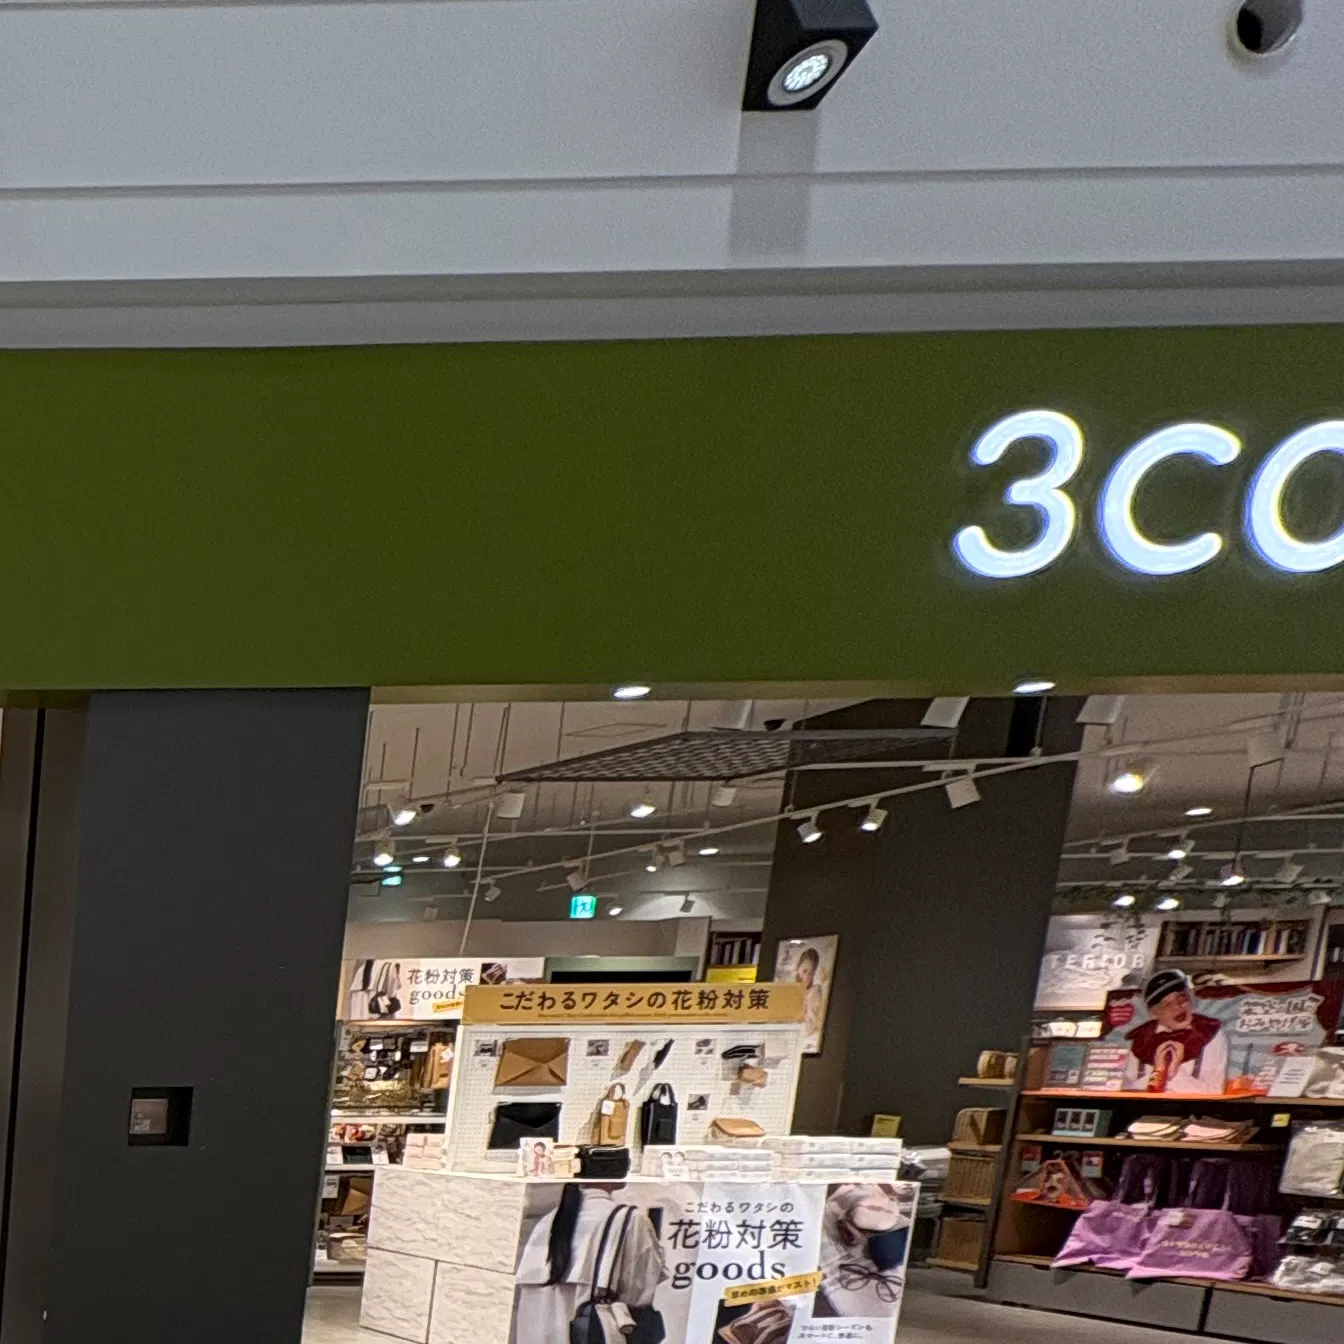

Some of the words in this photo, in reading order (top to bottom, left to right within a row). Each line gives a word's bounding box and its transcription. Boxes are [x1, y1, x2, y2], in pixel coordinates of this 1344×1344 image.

[407, 968, 475, 984] 花粉対策
[500, 988, 771, 1011] こだわるワタシの花粉対策
[684, 1201, 794, 1214] こだわるワタシの
[668, 1218, 804, 1251] 花粉対策
[671, 1251, 787, 1290] goods
